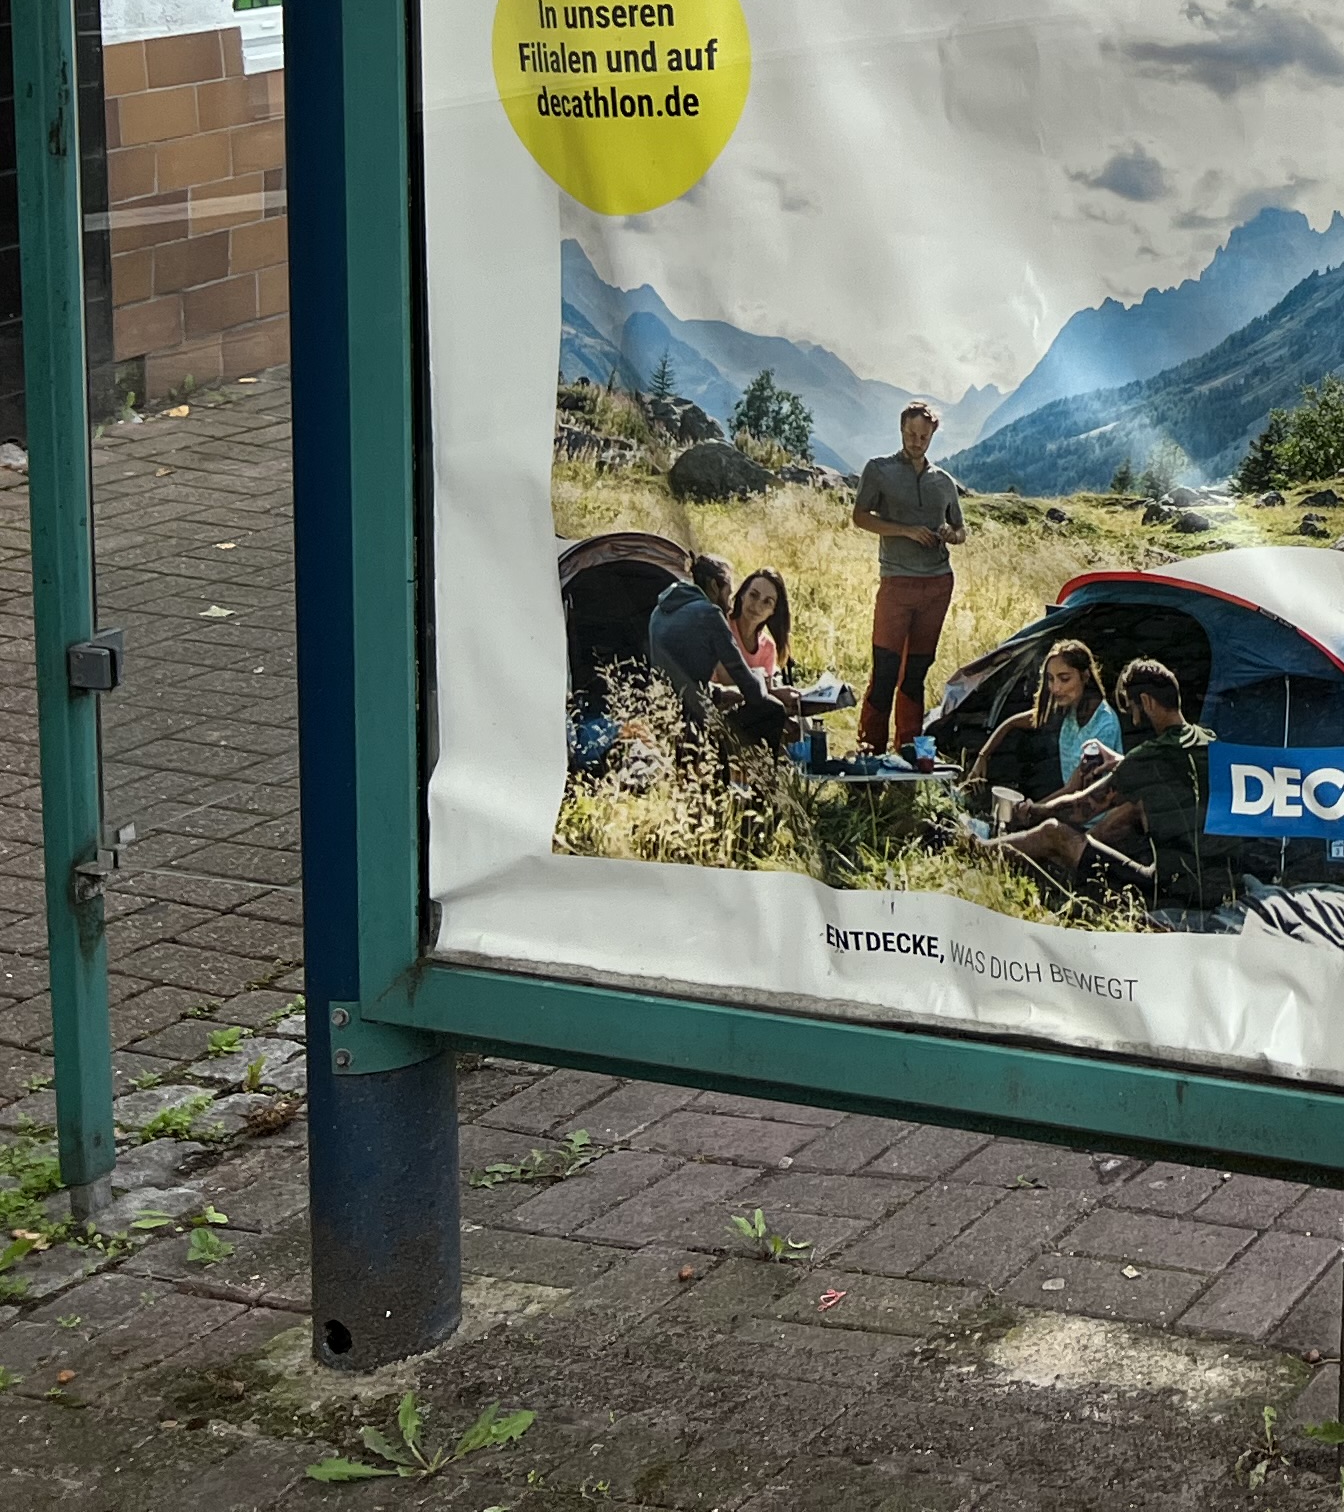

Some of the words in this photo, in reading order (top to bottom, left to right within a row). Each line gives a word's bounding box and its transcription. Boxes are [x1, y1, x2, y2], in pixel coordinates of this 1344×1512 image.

[539, 0, 558, 29] In
[563, 3, 675, 29] unseren
[518, 41, 598, 73] Filialen
[606, 41, 658, 73] und
[667, 38, 718, 71] auf
[537, 85, 700, 118] decathlon.de
[826, 923, 945, 964] ENTDECKE,
[950, 939, 986, 974] WAS
[990, 955, 1042, 983] DICH
[1049, 963, 1139, 1002] BEWEGT
